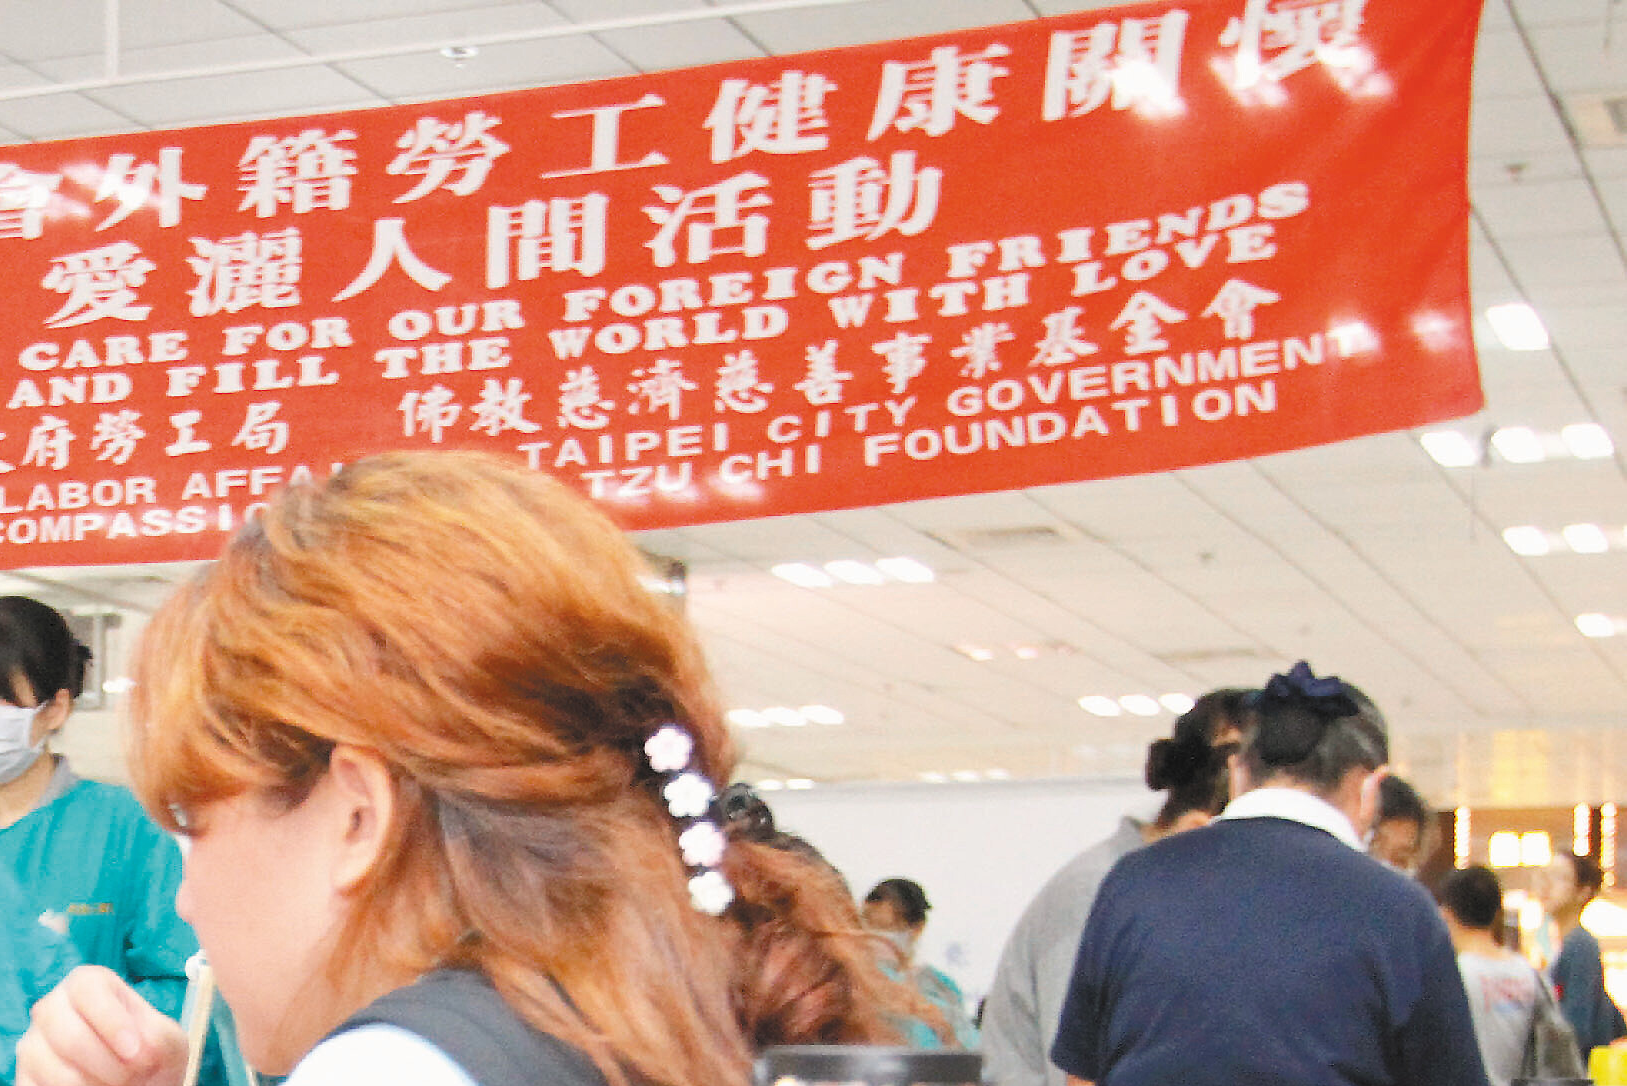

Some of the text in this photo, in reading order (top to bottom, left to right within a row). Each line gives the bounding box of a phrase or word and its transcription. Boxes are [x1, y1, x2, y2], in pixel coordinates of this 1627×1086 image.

[7, 373, 132, 409] AND
[166, 357, 340, 397] FILL
[375, 337, 512, 379] THE
[548, 306, 789, 359] WORLD
[830, 273, 1029, 328] WITH
[1073, 225, 1277, 296] LOVE
[18, 333, 187, 371] CARE
[222, 317, 353, 355] FOR
[388, 300, 525, 341] OUR
[564, 253, 904, 322] FOREIGN
[948, 184, 1309, 278] FRIENDS
[42, 151, 943, 329] 愛灑人間活動
[181, 463, 343, 500] AFFA
[517, 423, 728, 471] TAIPEI
[767, 398, 916, 443] CITY
[948, 321, 1370, 418] GOVERNMENT
[580, 462, 693, 499] TZU
[718, 446, 820, 484] CHI
[866, 381, 1277, 467] FOUNDATION
